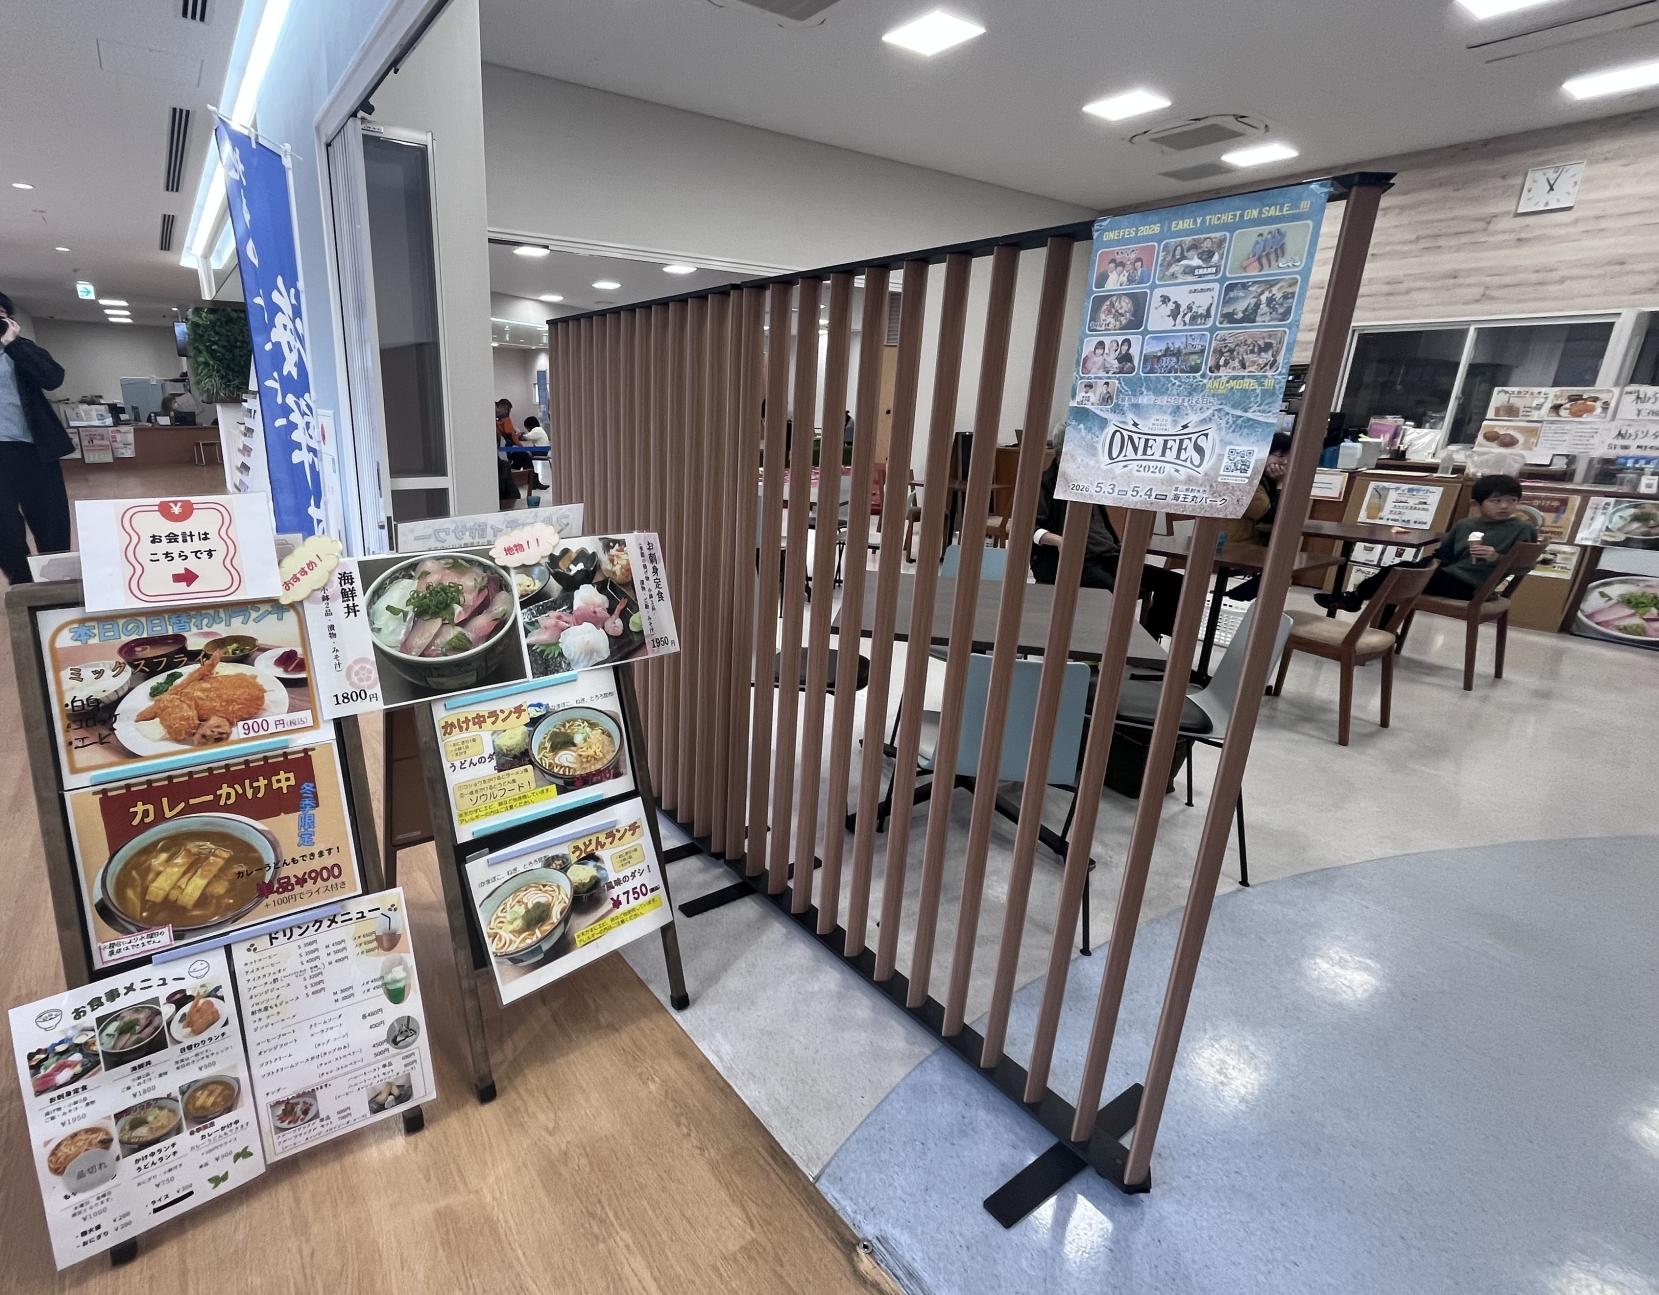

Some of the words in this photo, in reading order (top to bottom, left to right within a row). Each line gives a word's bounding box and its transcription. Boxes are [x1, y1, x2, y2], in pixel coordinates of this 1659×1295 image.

[1103, 227, 1136, 241] ONEFES
[1137, 224, 1161, 236] 2026
[1171, 217, 1203, 231] EARLY
[1243, 207, 1259, 220] ON
[1108, 429, 1157, 461] ONE
[1159, 433, 1209, 468] FES
[1136, 464, 1166, 474] 2026
[1094, 482, 1116, 495] 5.3
[149, 531, 211, 545] お会計は
[149, 548, 217, 562] こちらです
[646, 541, 665, 602] お刺身定食
[337, 571, 361, 619] 海鮮丼
[69, 603, 290, 645] 本日の日替わりランチ
[69, 654, 207, 682] ミックスフライ
[242, 719, 270, 735] 900
[442, 703, 526, 736] かけ中ランチ
[129, 770, 296, 826] カレーかけ中
[298, 782, 316, 847] 冬季限定
[571, 821, 641, 857] うどんランチ
[268, 907, 381, 946] ドリンクメニュー
[71, 977, 186, 1021] お食事メニュー
